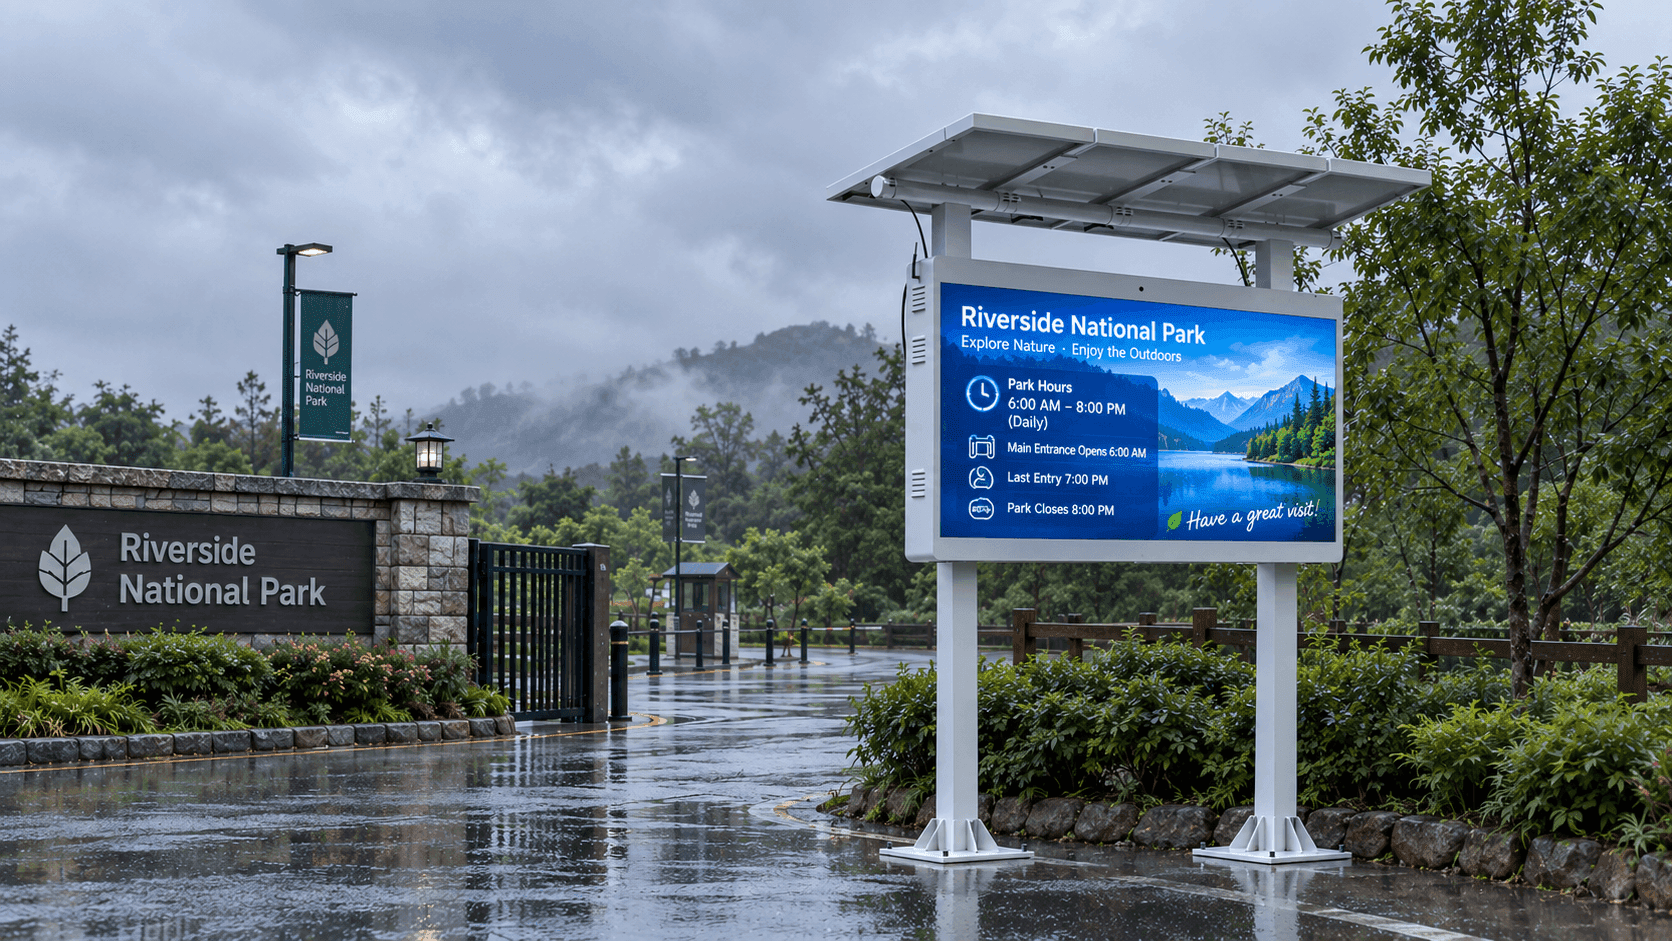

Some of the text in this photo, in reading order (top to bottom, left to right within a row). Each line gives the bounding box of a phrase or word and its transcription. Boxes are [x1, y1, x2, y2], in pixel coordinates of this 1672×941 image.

[961, 305, 1206, 345] Riverside National Park
[961, 335, 1009, 351] Explore
[1013, 338, 1055, 353] Nature
[1072, 343, 1104, 360] Enjoy
[1107, 345, 1126, 358] the
[1130, 347, 1182, 362] Outdoors
[305, 369, 347, 382] Riverside
[305, 382, 345, 395] National
[1008, 378, 1073, 393] Park Hours
[305, 395, 328, 406] Park
[1008, 397, 1036, 410] 6:00
[1040, 399, 1061, 412] AM
[1076, 401, 1103, 414] 8:00
[1107, 402, 1126, 415] PM
[1008, 414, 1048, 431] (Daily)
[1007, 442, 1147, 458] Main Entrance Opens 6:00 AM
[1007, 471, 1109, 486] Last Entry 7:00 PM
[1007, 502, 1115, 516] Park Closes 8:00 PM
[1186, 498, 1320, 532] Have a great visit!
[120, 531, 256, 566] Riverside
[119, 573, 326, 607] National Park
